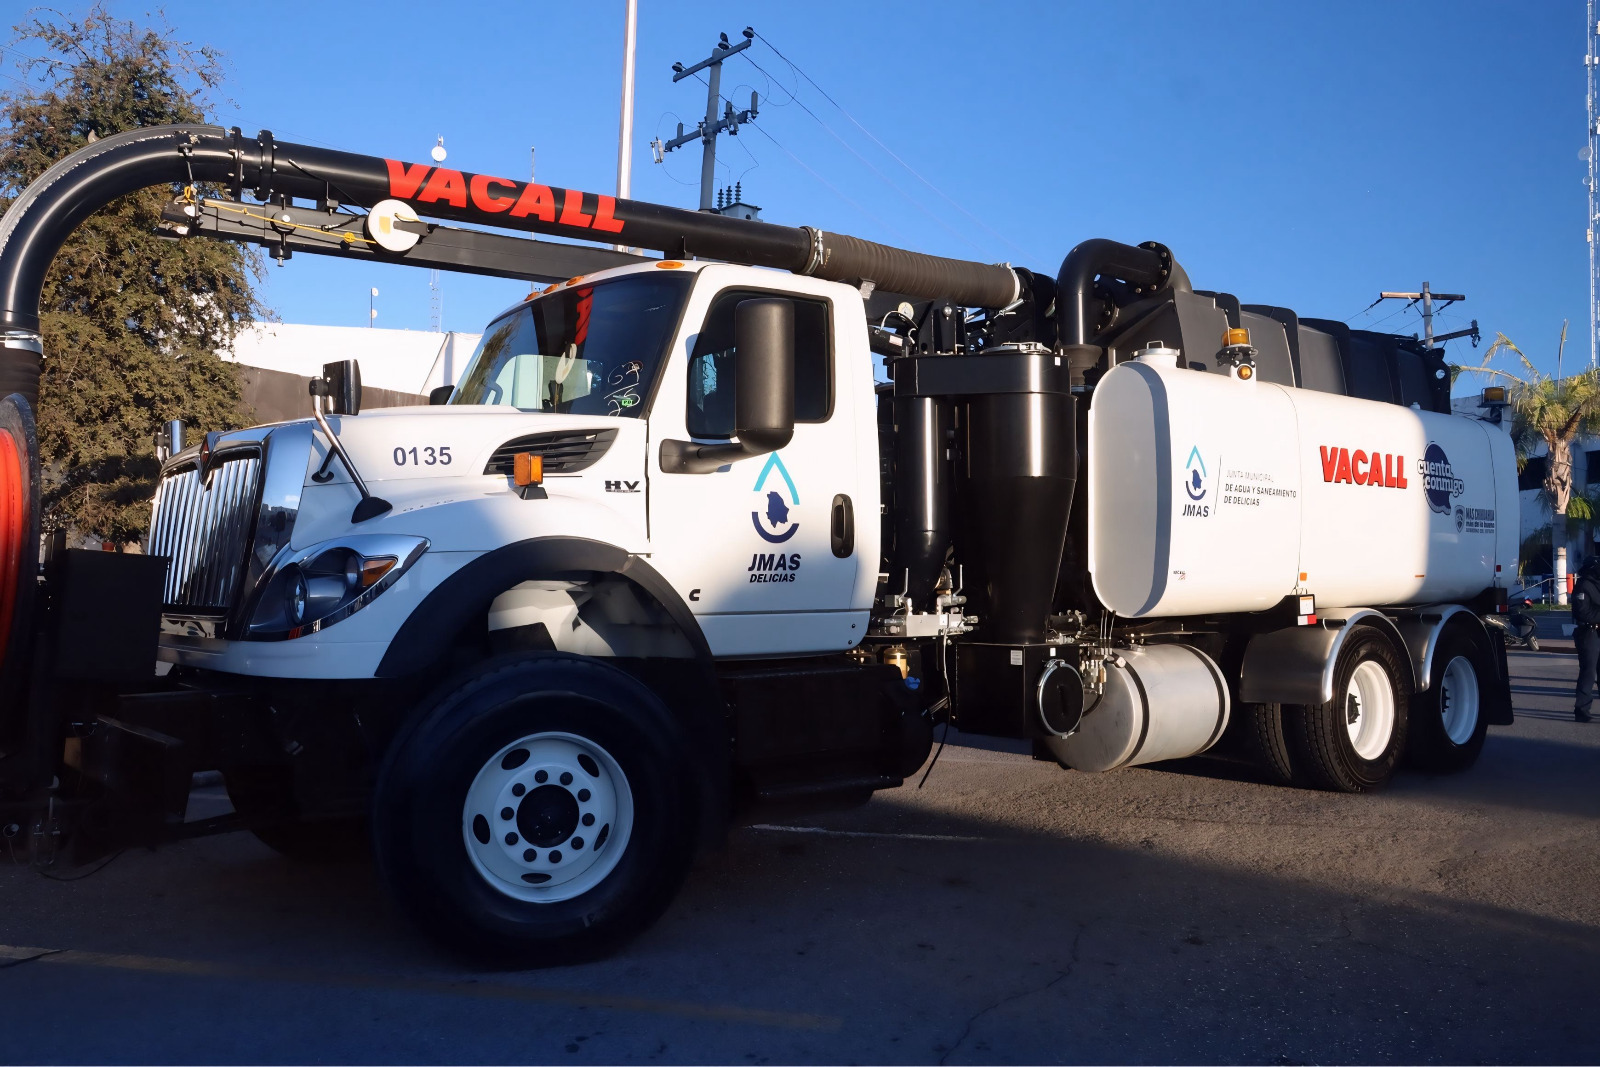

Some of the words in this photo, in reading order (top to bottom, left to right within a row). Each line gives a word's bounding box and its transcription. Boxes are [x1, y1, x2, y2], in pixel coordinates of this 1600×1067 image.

[384, 158, 625, 233] VACALL
[393, 446, 452, 466] 0135
[1320, 445, 1407, 489] VACALL
[1417, 459, 1453, 479] cuenta
[604, 480, 641, 490] HV
[1225, 483, 1233, 492] DE
[1234, 484, 1251, 494] AGUA
[1256, 486, 1297, 498] SANEAMIENTO
[1424, 475, 1464, 497] conmigo
[1223, 495, 1232, 504] DE
[1233, 496, 1260, 506] DELICIAS
[1182, 503, 1210, 518] JMAS
[748, 553, 802, 572] JMAS
[749, 573, 796, 584] DELICIAS
